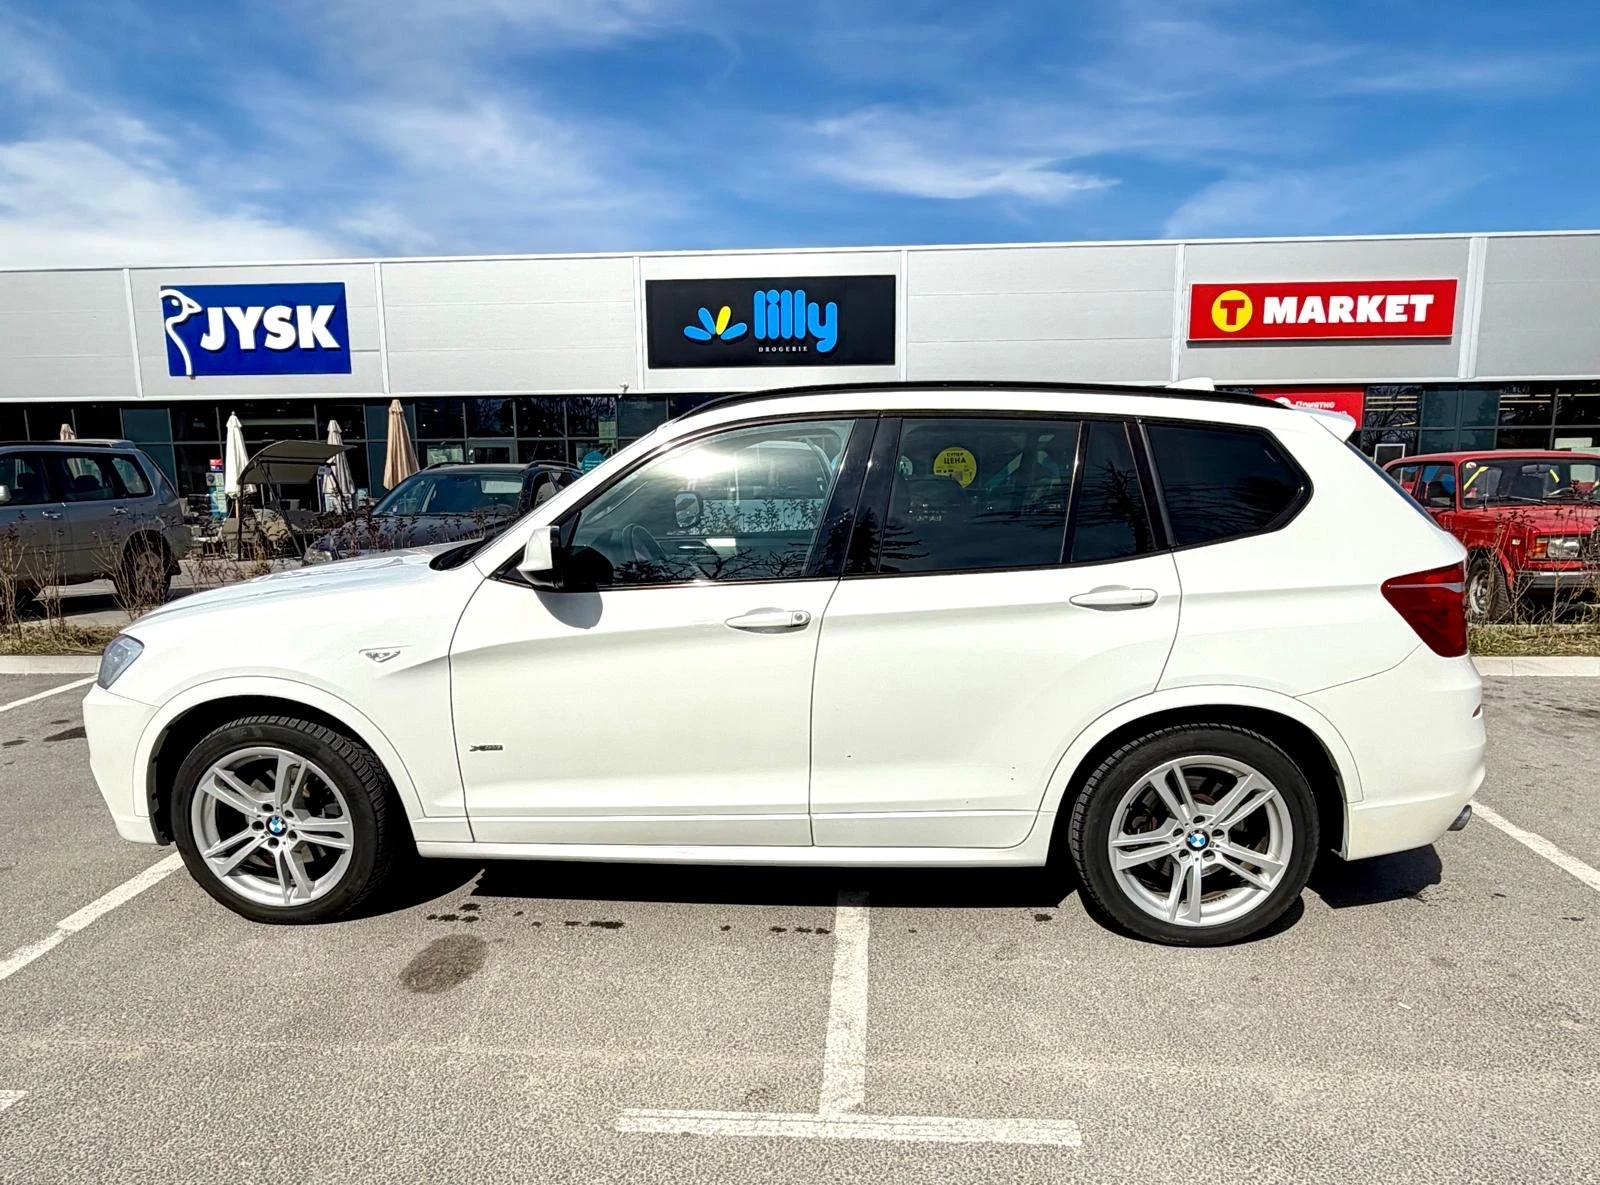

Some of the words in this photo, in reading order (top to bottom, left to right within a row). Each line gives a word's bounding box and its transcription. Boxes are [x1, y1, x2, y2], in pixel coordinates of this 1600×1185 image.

[200, 305, 340, 351] JYSK
[754, 289, 838, 353] lilly
[1219, 300, 1245, 326] T
[1263, 294, 1434, 324] MARKET
[943, 457, 967, 465] ЦЕНА
